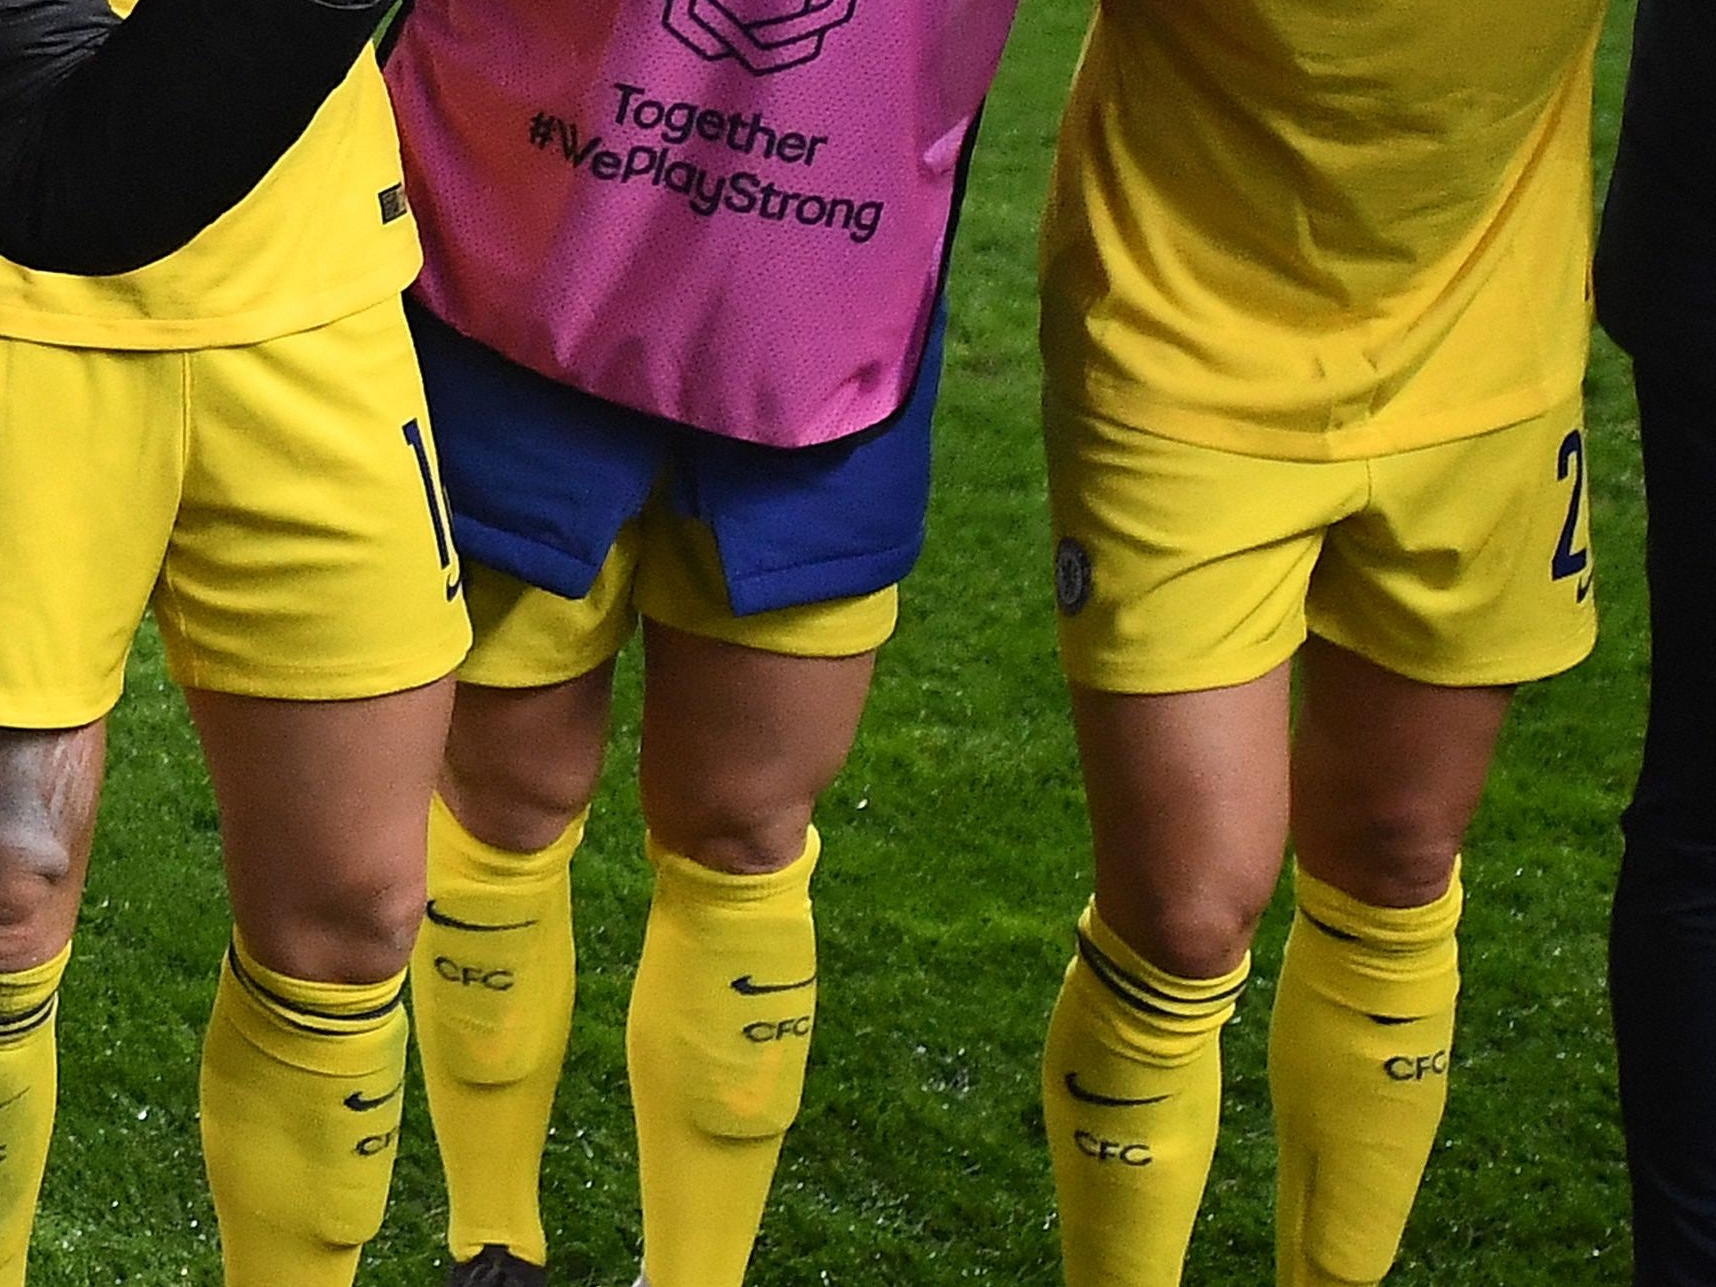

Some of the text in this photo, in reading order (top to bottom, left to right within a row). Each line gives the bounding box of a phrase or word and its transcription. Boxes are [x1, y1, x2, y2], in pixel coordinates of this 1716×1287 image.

[613, 82, 828, 166] Together
[528, 110, 885, 244] #WePlayStrong
[433, 955, 515, 992] CFC
[742, 1014, 811, 1044] CFC
[1383, 1049, 1447, 1081] CFC
[1072, 1129, 1153, 1168] CFC
